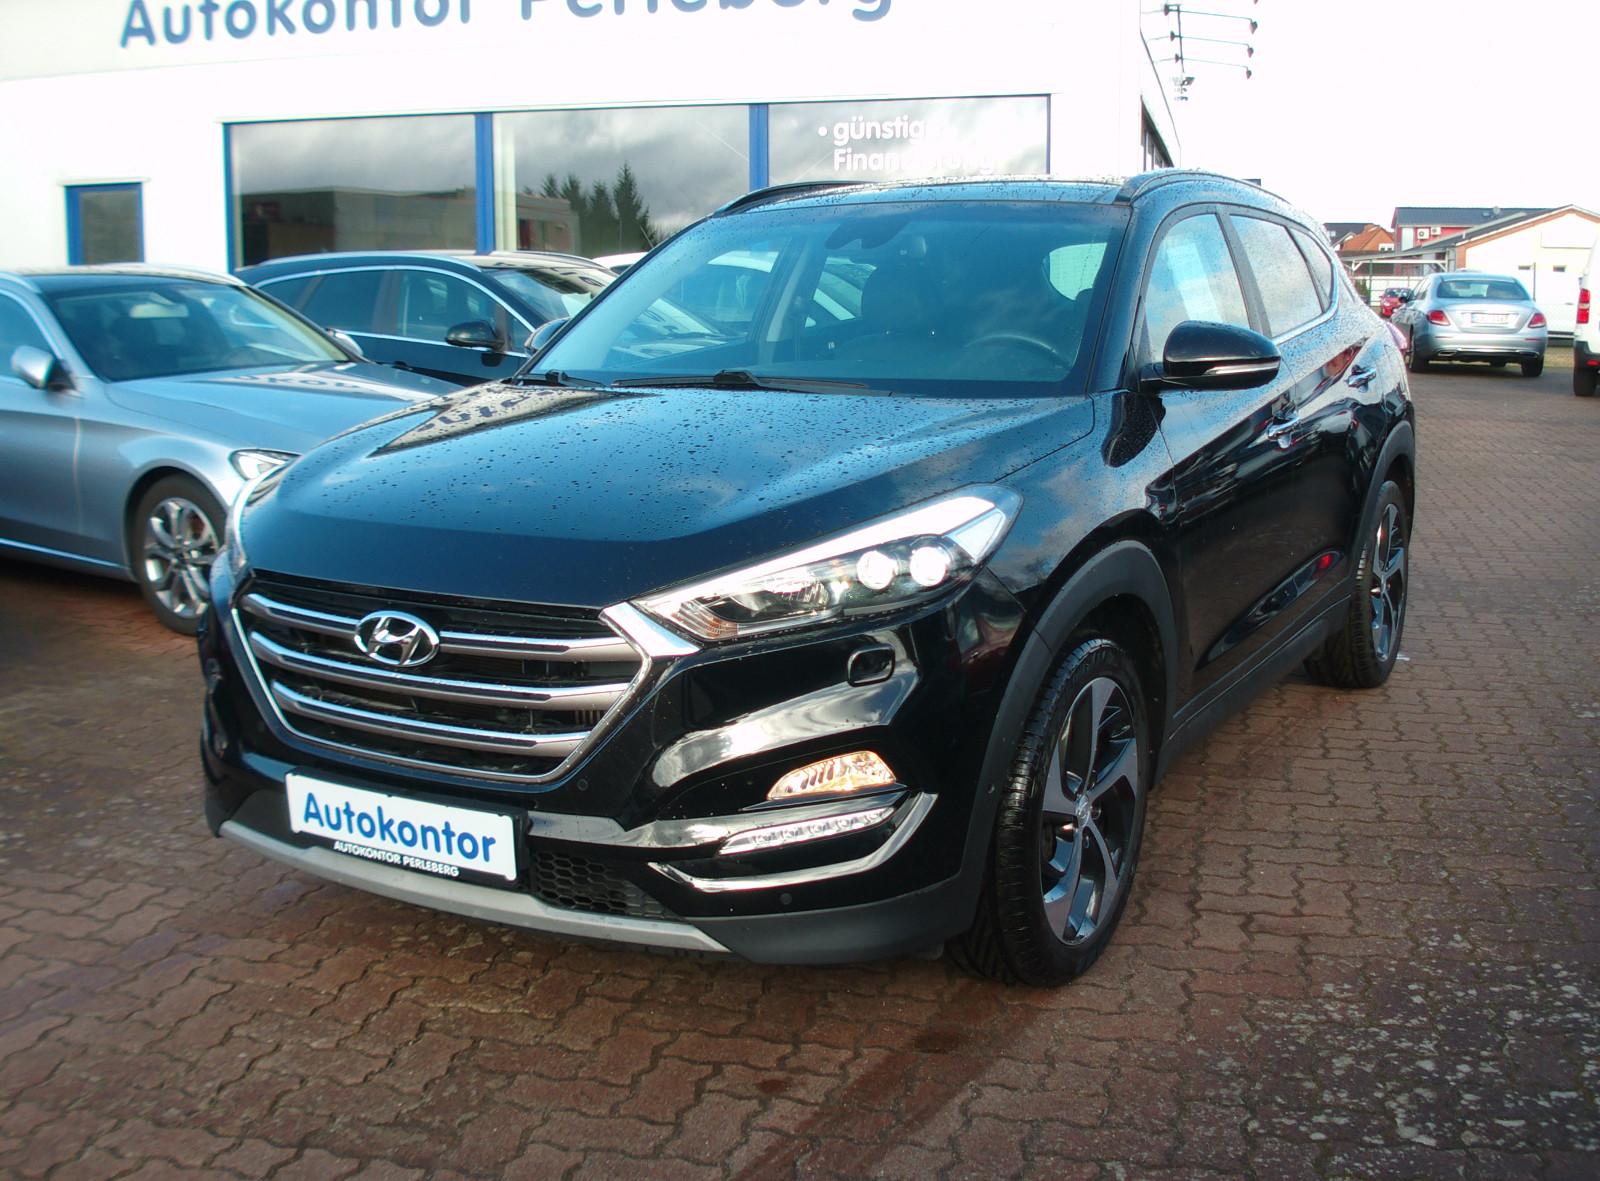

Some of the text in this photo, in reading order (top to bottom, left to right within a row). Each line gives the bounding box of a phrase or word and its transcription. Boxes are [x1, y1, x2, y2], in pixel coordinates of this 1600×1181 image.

[833, 114, 932, 146] günstig
[304, 792, 496, 862] Autokontor
[333, 841, 459, 877] AUTOKONTOR PERLEBERG
